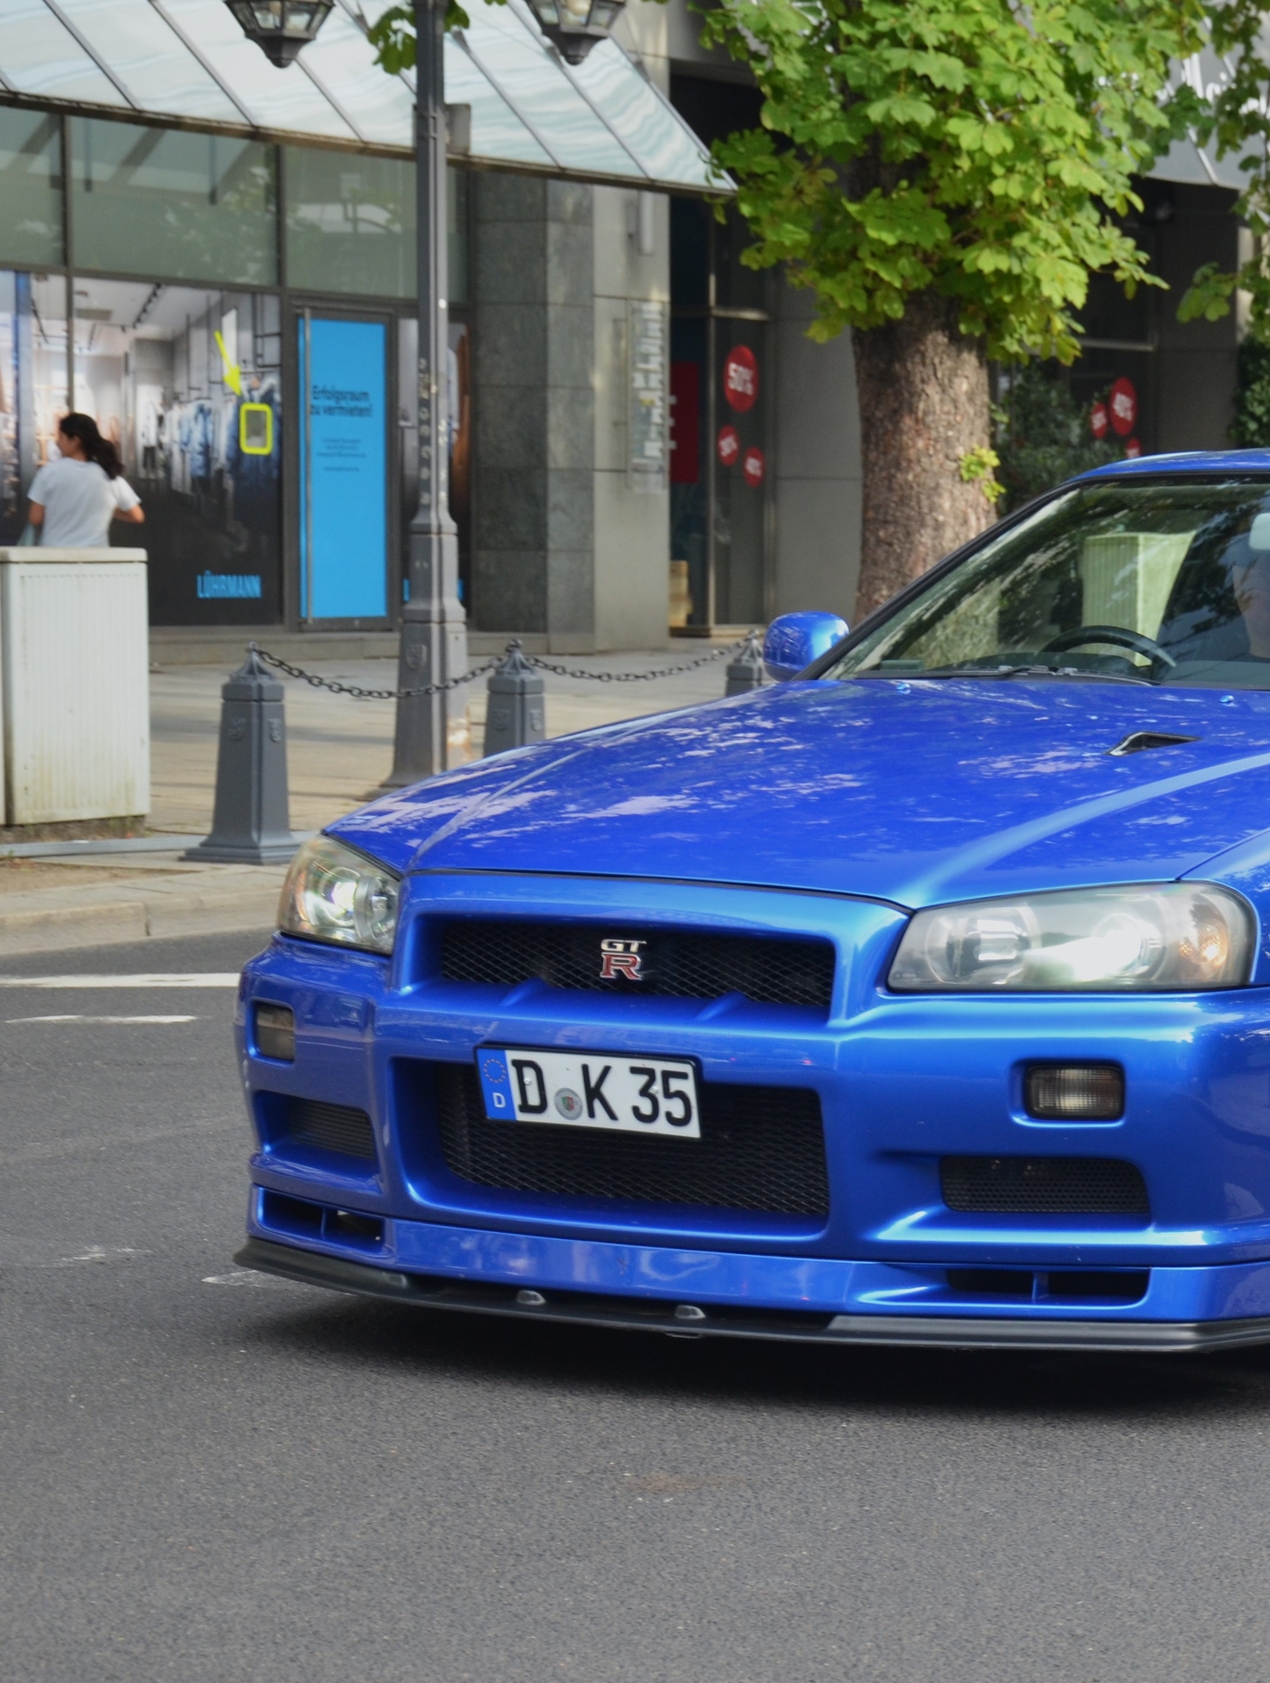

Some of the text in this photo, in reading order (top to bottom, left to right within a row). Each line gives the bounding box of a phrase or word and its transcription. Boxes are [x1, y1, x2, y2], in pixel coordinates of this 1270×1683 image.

[728, 361, 754, 396] 50%
[197, 569, 262, 599] LÜHRMANN
[600, 938, 647, 953] GT
[599, 951, 643, 981] R
[492, 1092, 506, 1108] D
[511, 1059, 693, 1127] D K 35
